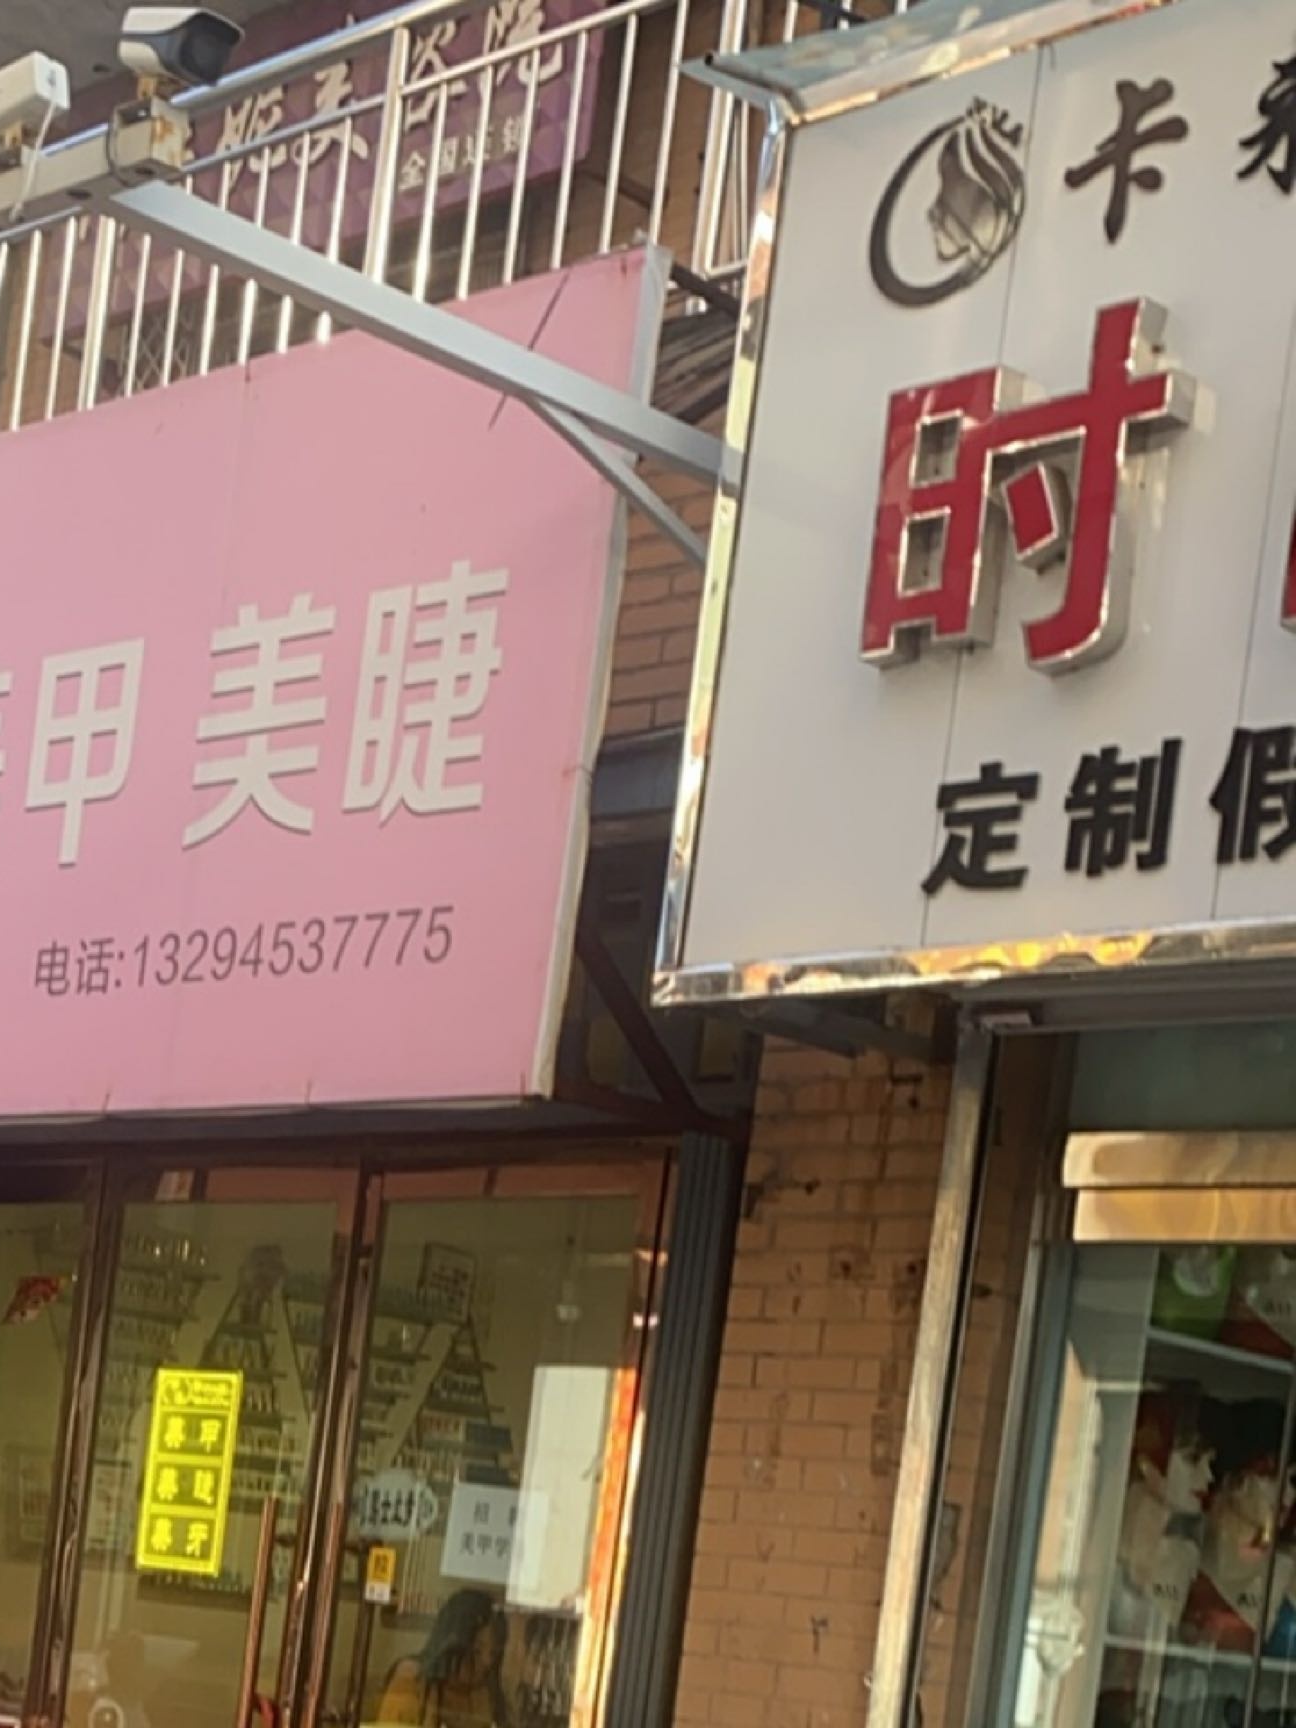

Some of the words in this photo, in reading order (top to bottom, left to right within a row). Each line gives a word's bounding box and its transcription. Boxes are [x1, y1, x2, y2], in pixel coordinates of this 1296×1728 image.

[861, 296, 1296, 676] 时
[182, 559, 510, 850] 美睫
[921, 727, 1296, 898] 定制假
[32, 904, 456, 998] 电话:13294537775
